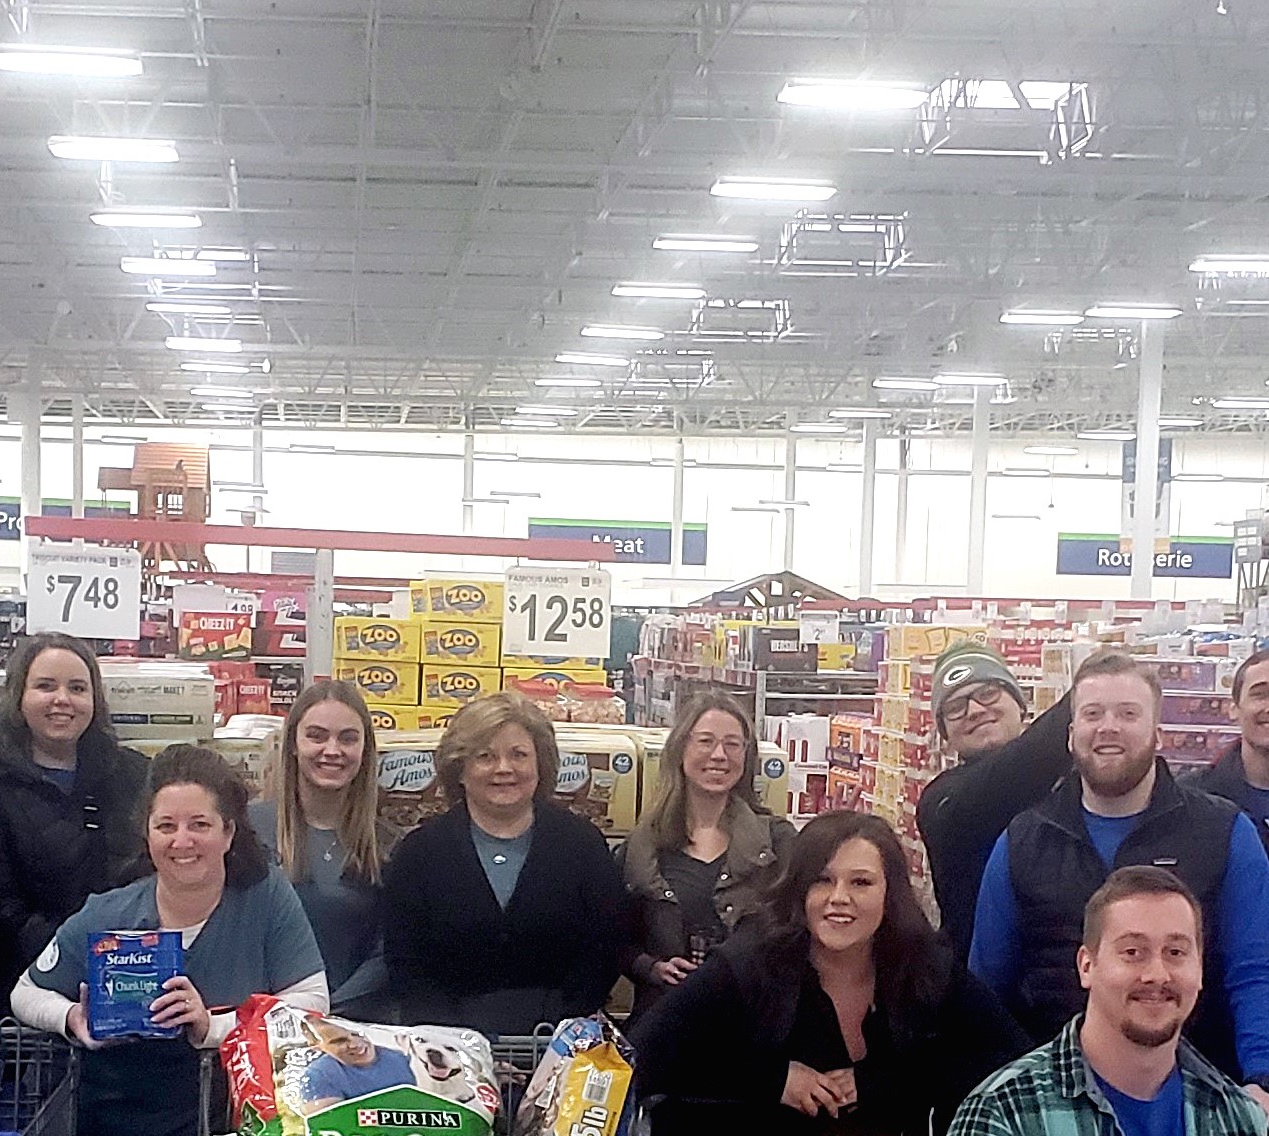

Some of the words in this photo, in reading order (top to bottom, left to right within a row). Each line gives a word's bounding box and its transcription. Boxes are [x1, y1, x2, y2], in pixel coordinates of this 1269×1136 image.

[1097, 549, 1193, 569] Roterie
[508, 574, 544, 584] FAMOUS
[545, 575, 569, 585] AMOS
[446, 588, 483, 604] ZOO
[361, 628, 397, 643] ZOO
[440, 632, 477, 648] ZOO
[359, 670, 395, 684] ZOO
[441, 675, 478, 690] ZOO
[371, 715, 394, 728] OO
[767, 761, 782, 771] 42
[389, 767, 434, 790] Amos
[558, 771, 587, 783] mos
[106, 952, 153, 965] StarKist
[115, 980, 139, 991] Chunk
[140, 980, 158, 993] Light
[381, 1112, 458, 1127] PURINA
